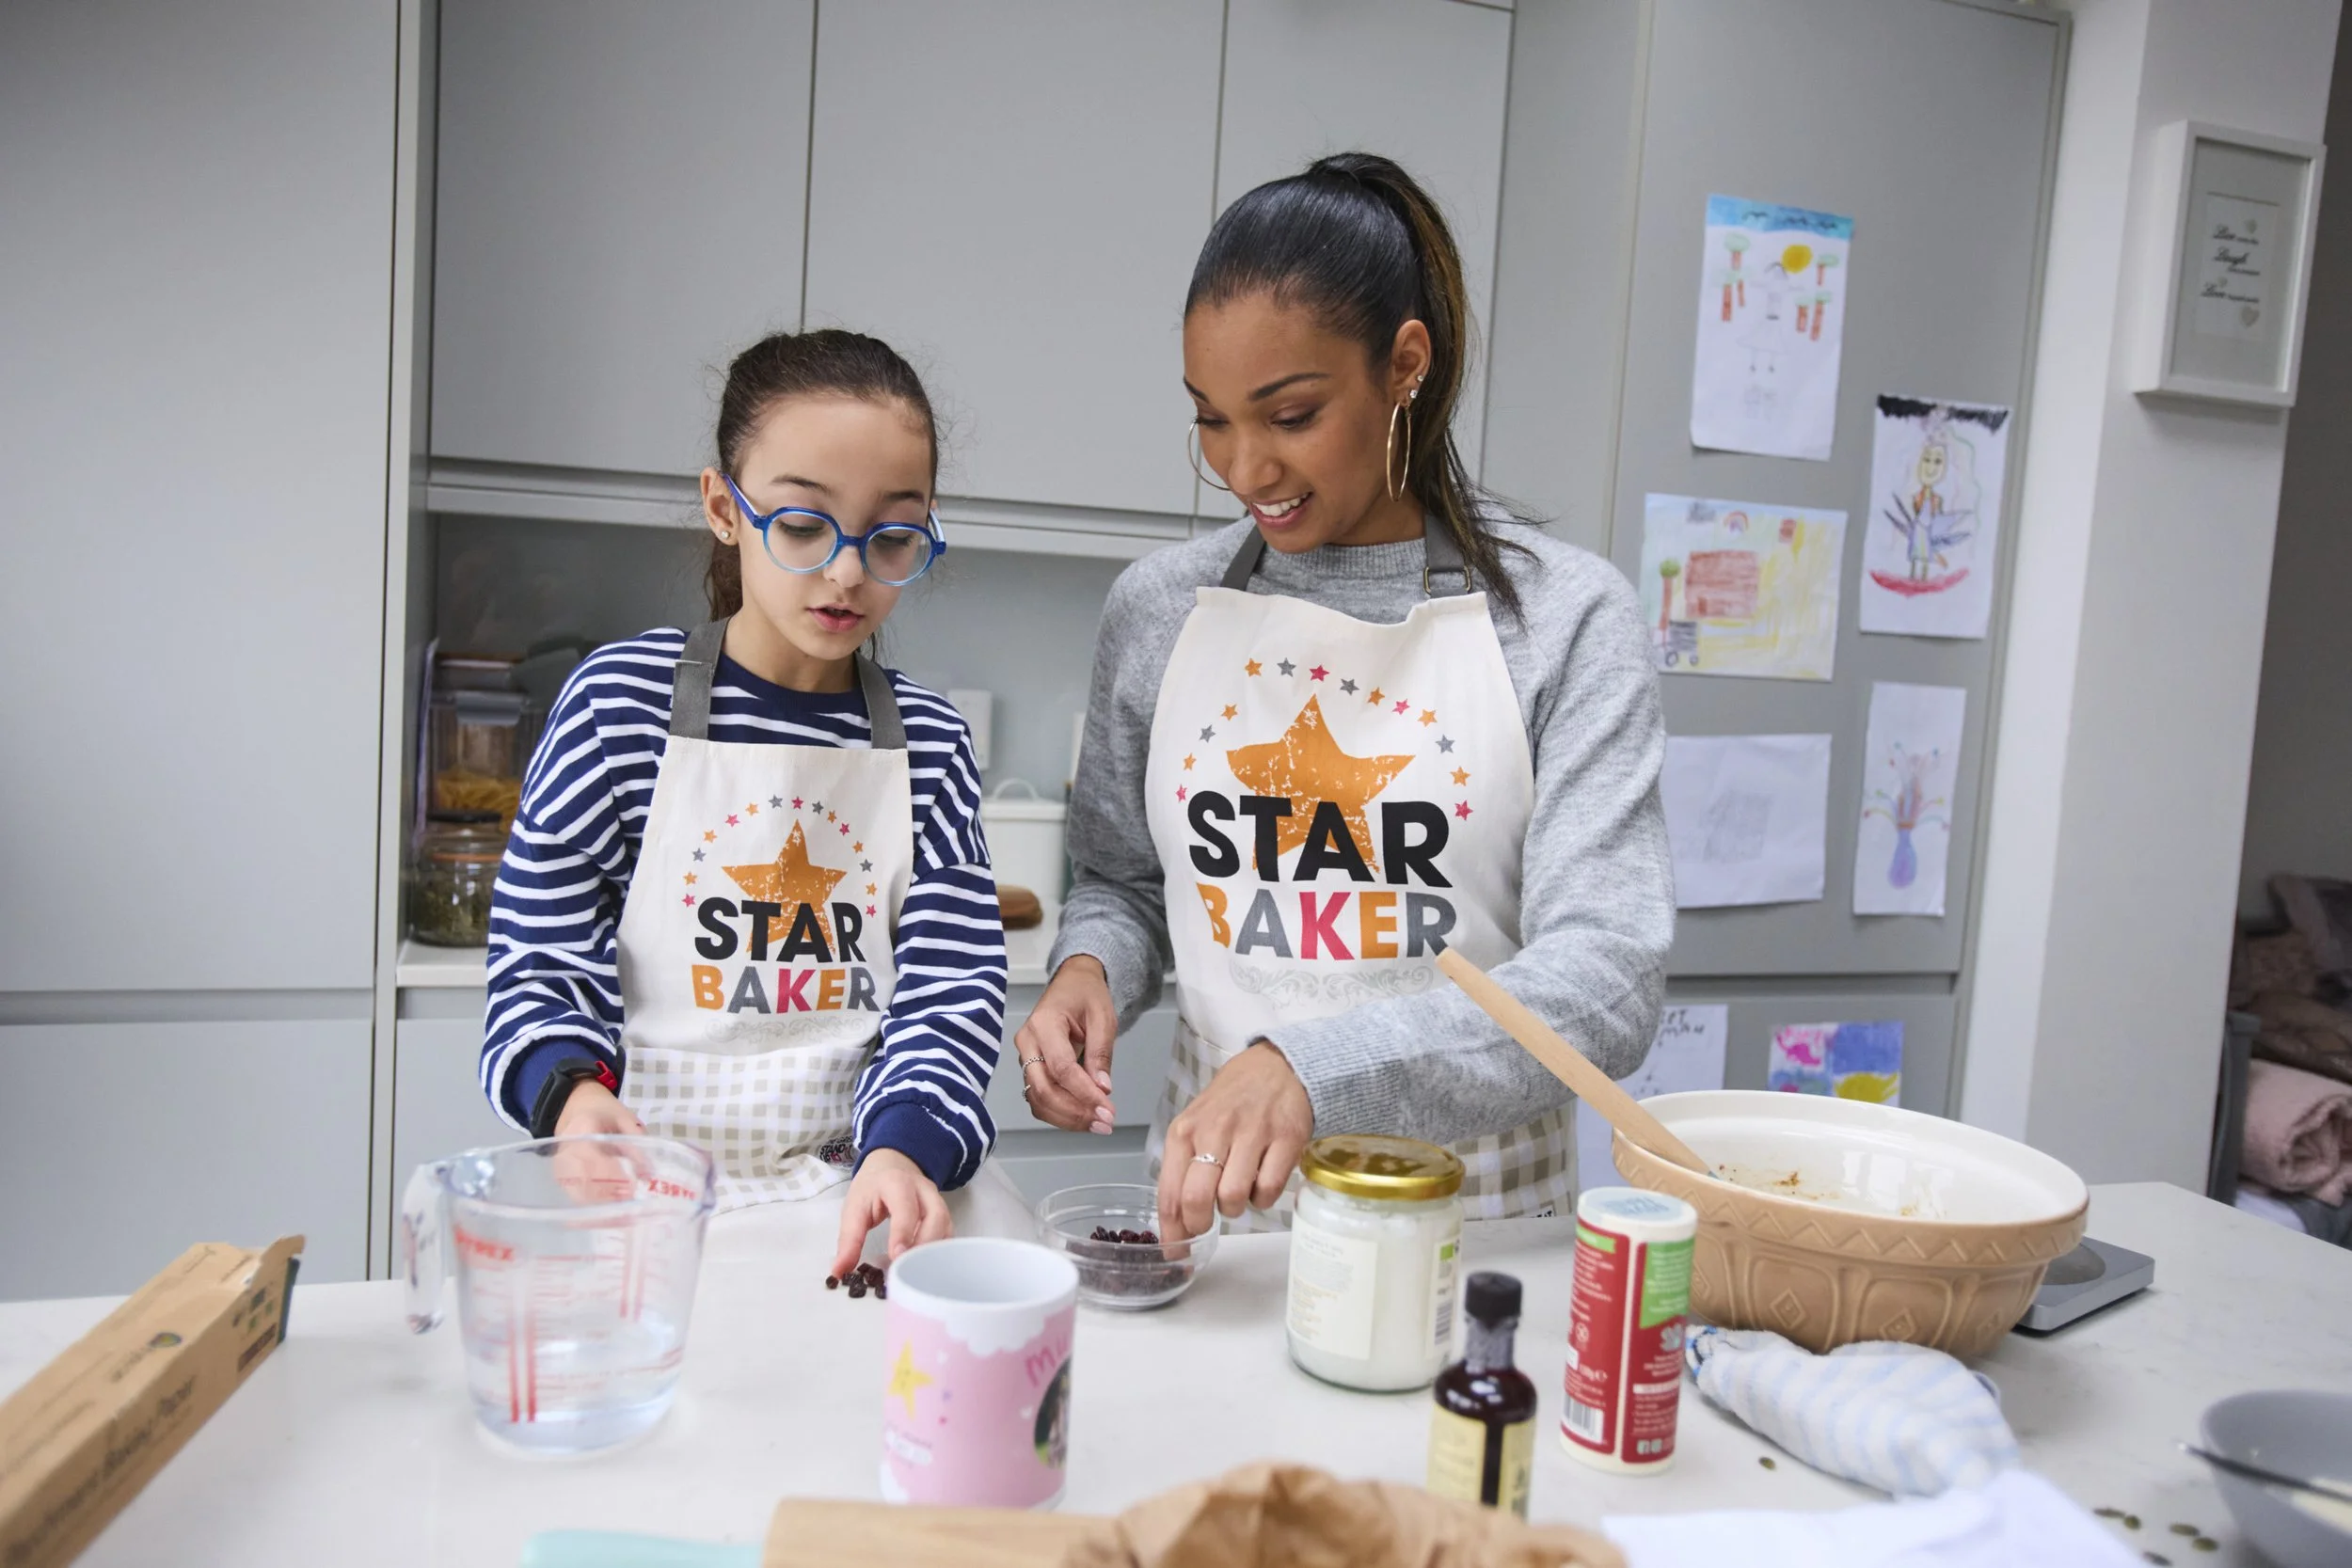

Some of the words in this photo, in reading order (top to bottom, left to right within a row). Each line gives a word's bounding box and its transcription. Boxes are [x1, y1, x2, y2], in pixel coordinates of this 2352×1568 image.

[1187, 790, 1454, 888] STAR
[694, 896, 866, 963] STAR
[1196, 881, 1457, 961] BAKER
[691, 964, 882, 1015] BAKER
